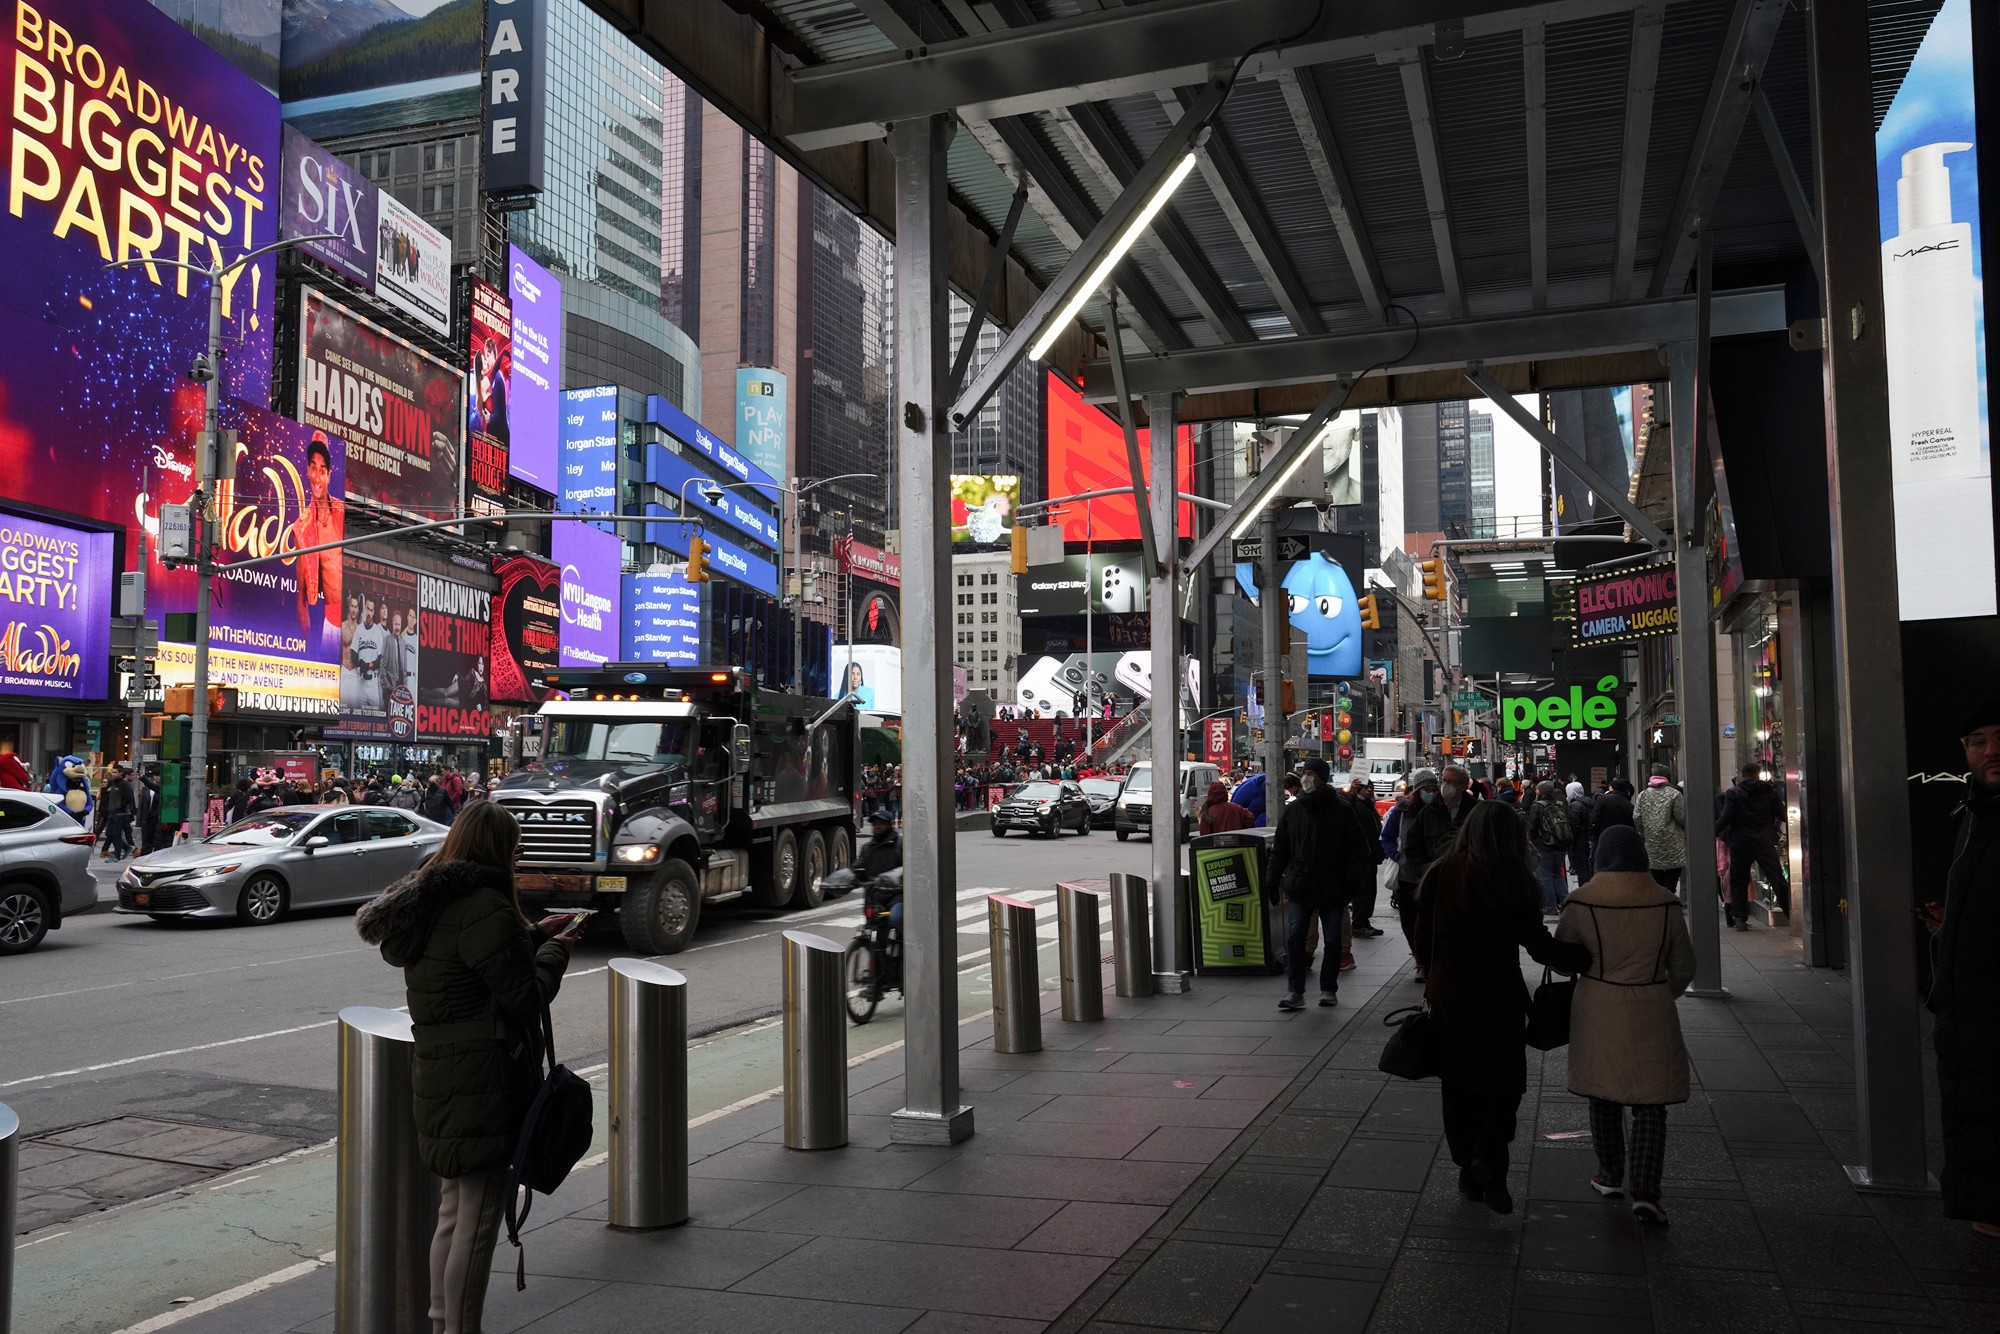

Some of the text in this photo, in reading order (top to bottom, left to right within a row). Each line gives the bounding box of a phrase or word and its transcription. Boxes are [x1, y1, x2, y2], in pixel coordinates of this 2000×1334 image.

[489, 0, 523, 155] ARE
[16, 0, 265, 193] BROADWAY'S
[13, 49, 264, 250] BIGGEST
[298, 155, 367, 254] SIX
[9, 128, 262, 331] PARTY!
[420, 269, 448, 300] WRONG
[473, 305, 488, 324] BEST
[480, 290, 493, 308] TONY
[493, 298, 510, 320] AWARDS
[528, 326, 538, 341] the
[513, 331, 550, 365] for neurology
[513, 346, 525, 360] and
[325, 349, 341, 366] COME
[341, 356, 352, 370] SEE
[365, 368, 375, 382] THE
[375, 372, 392, 390] WORLD
[392, 381, 408, 398] COULD
[513, 361, 550, 390] neurosurgery.
[596, 386, 617, 397] Stan
[306, 357, 431, 458] HADESTOWN
[602, 410, 617, 421] Mo
[305, 411, 348, 440] BROADWAY'S
[348, 428, 366, 446] TONY
[366, 436, 379, 450] AND
[595, 436, 617, 447] Stan
[1911, 427, 1952, 438] HYPER REAL
[1929, 436, 1955, 444] Canvas
[365, 449, 402, 477] MUSICAL
[601, 461, 616, 471] Mo
[696, 430, 749, 479] Stanley Morgan Stanley
[594, 486, 616, 497] Stan
[735, 504, 750, 524] Morgan
[748, 513, 762, 534] Stanley
[0, 528, 79, 557] OADWAY'S
[2, 546, 79, 580] GGEST
[370, 562, 379, 574] HIT
[379, 565, 386, 575] OF
[387, 566, 397, 579] THE
[718, 547, 748, 575] Morgan Stanley
[0, 570, 78, 611] ARTY!
[420, 574, 490, 622] BROADWAY'S
[564, 581, 581, 604] NYU
[581, 587, 612, 613] Langone
[653, 586, 697, 598] Morgan Stanley
[1032, 582, 1058, 591] Galaxy
[1058, 581, 1070, 590] S23
[645, 602, 671, 611] Stanley
[577, 608, 602, 631] Health
[653, 618, 696, 629] Morgan Stanley
[1581, 606, 1679, 638] CAMERA LUGGAG
[420, 611, 489, 658] SURE THING
[645, 634, 671, 643] Stanley
[0, 621, 81, 678] Aladdin
[652, 650, 696, 661] Morgan Stanley
[221, 657, 236, 669] THE
[238, 660, 257, 671] NEW
[259, 664, 304, 677] AMSTERDAM
[306, 667, 338, 682] THEATRE,
[221, 672, 239, 685] AND
[253, 675, 283, 689] AVENUE
[5, 677, 73, 689] BROADWAY MUSICAL
[238, 691, 340, 716] GLE OUTFITTERS
[390, 698, 414, 721] TAKE ME
[1502, 674, 1618, 741] pelé
[347, 721, 372, 731] FEBRUARY
[394, 720, 407, 735] OUT
[417, 704, 490, 737] CHICAGO
[1211, 718, 1226, 752] tkts
[1528, 730, 1601, 741] SOCCER
[515, 812, 586, 822] MACK
[1206, 858, 1234, 870] EXPLORE
[1207, 868, 1227, 878] MORE
[1209, 873, 1236, 885] IN TIMES
[1211, 881, 1237, 893] SQUARE
